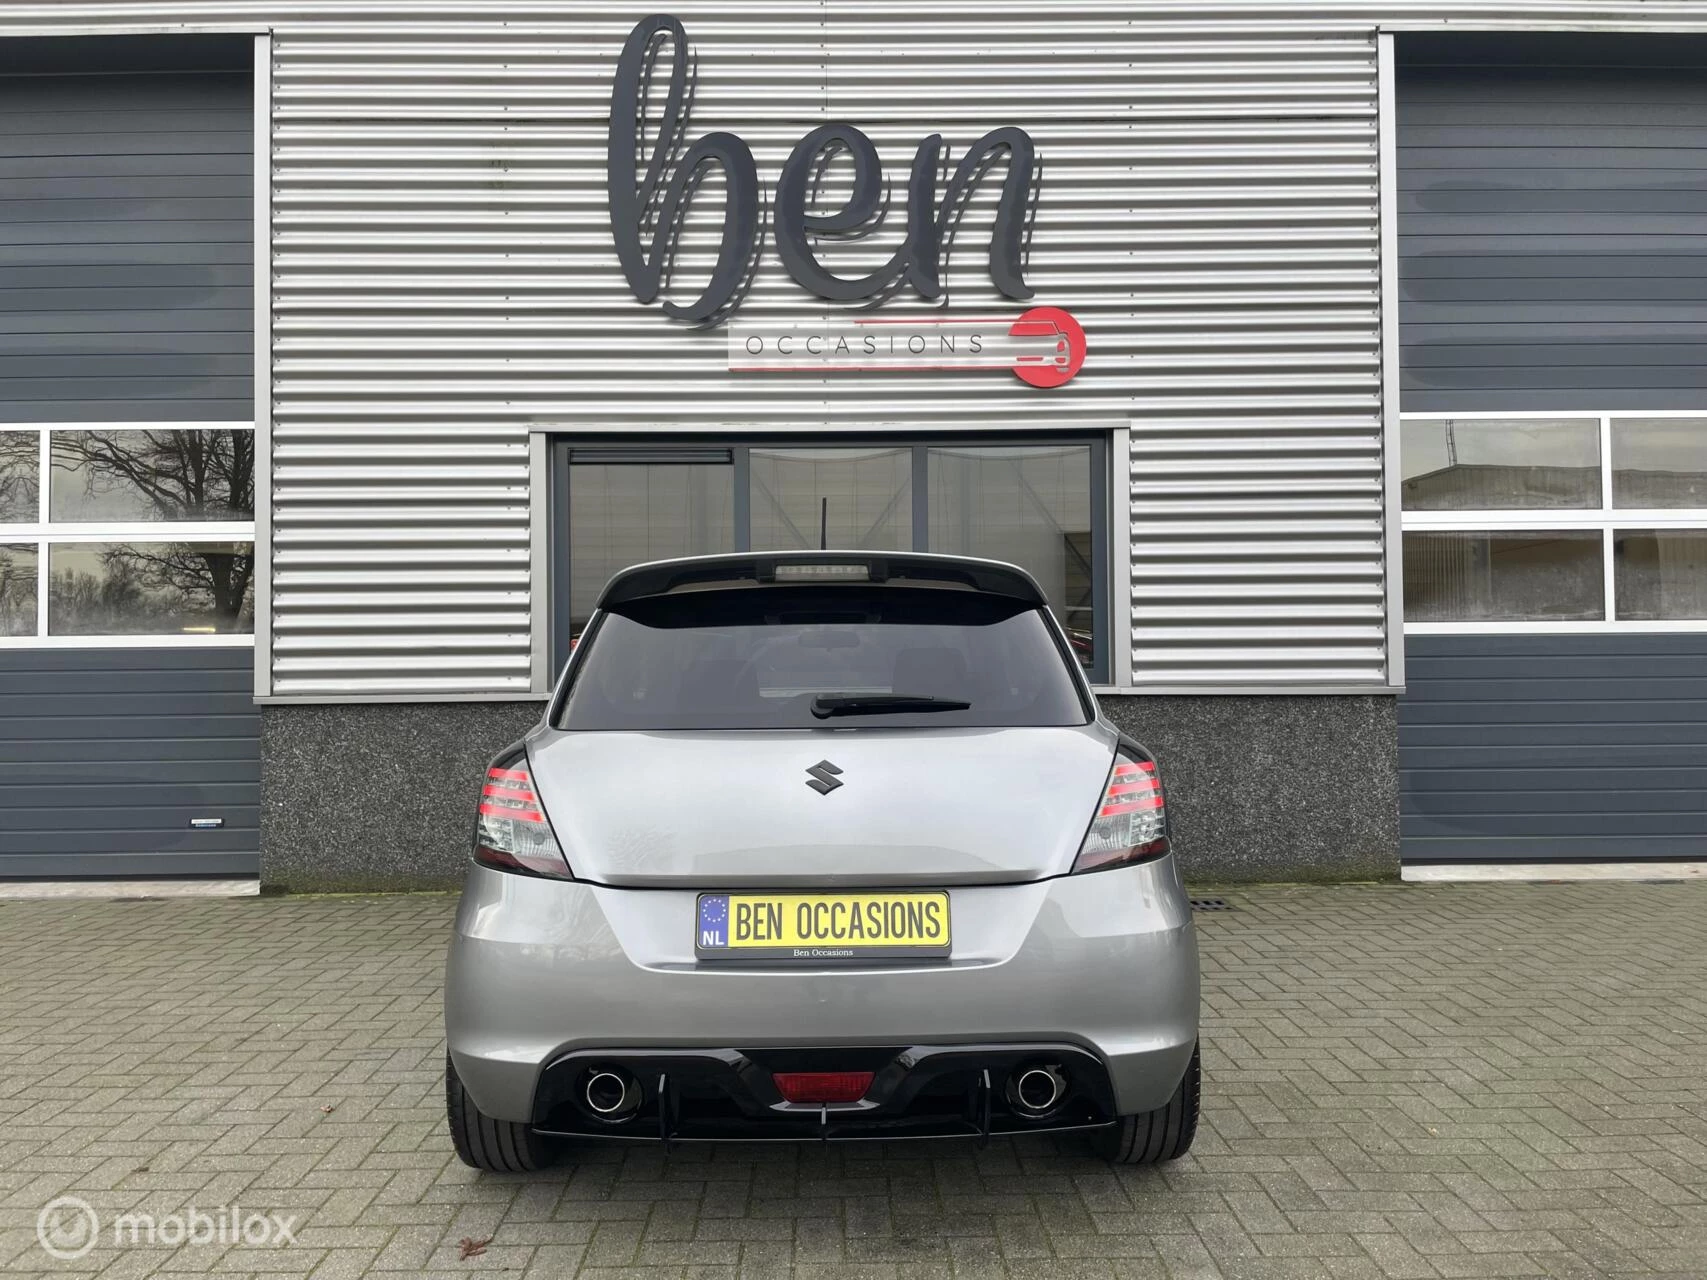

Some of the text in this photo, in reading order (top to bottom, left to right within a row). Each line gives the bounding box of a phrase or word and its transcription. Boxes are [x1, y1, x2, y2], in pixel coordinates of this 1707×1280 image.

[607, 13, 1036, 323] ben
[745, 335, 983, 355] OCCASIONS
[736, 901, 941, 940] BEN OCCASIONS
[702, 930, 724, 946] NL
[793, 949, 854, 957] Ben Occasions
